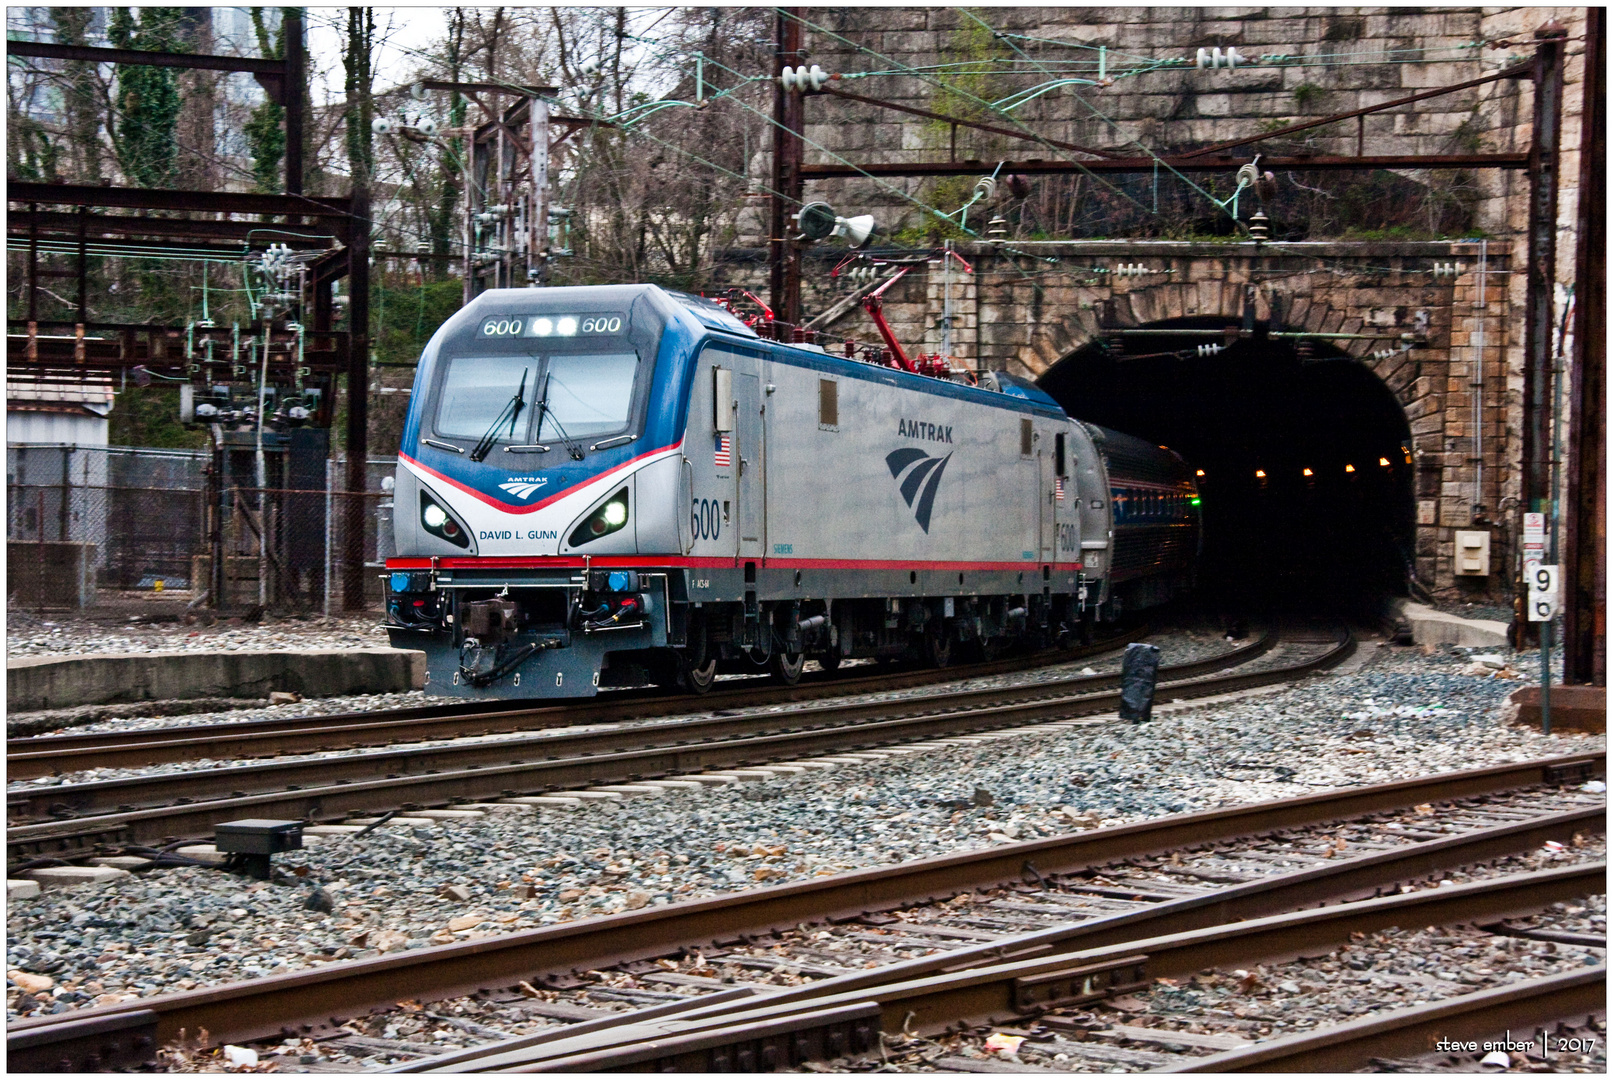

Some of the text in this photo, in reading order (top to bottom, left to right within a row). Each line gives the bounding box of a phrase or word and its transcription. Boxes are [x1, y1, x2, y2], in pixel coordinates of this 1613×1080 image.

[483, 320, 522, 335] 600
[582, 317, 621, 333] 600
[898, 418, 953, 444] AMTRAK
[691, 498, 720, 540] 600
[480, 531, 558, 540] DAVID L. GUNN
[1536, 569, 1550, 591] 9
